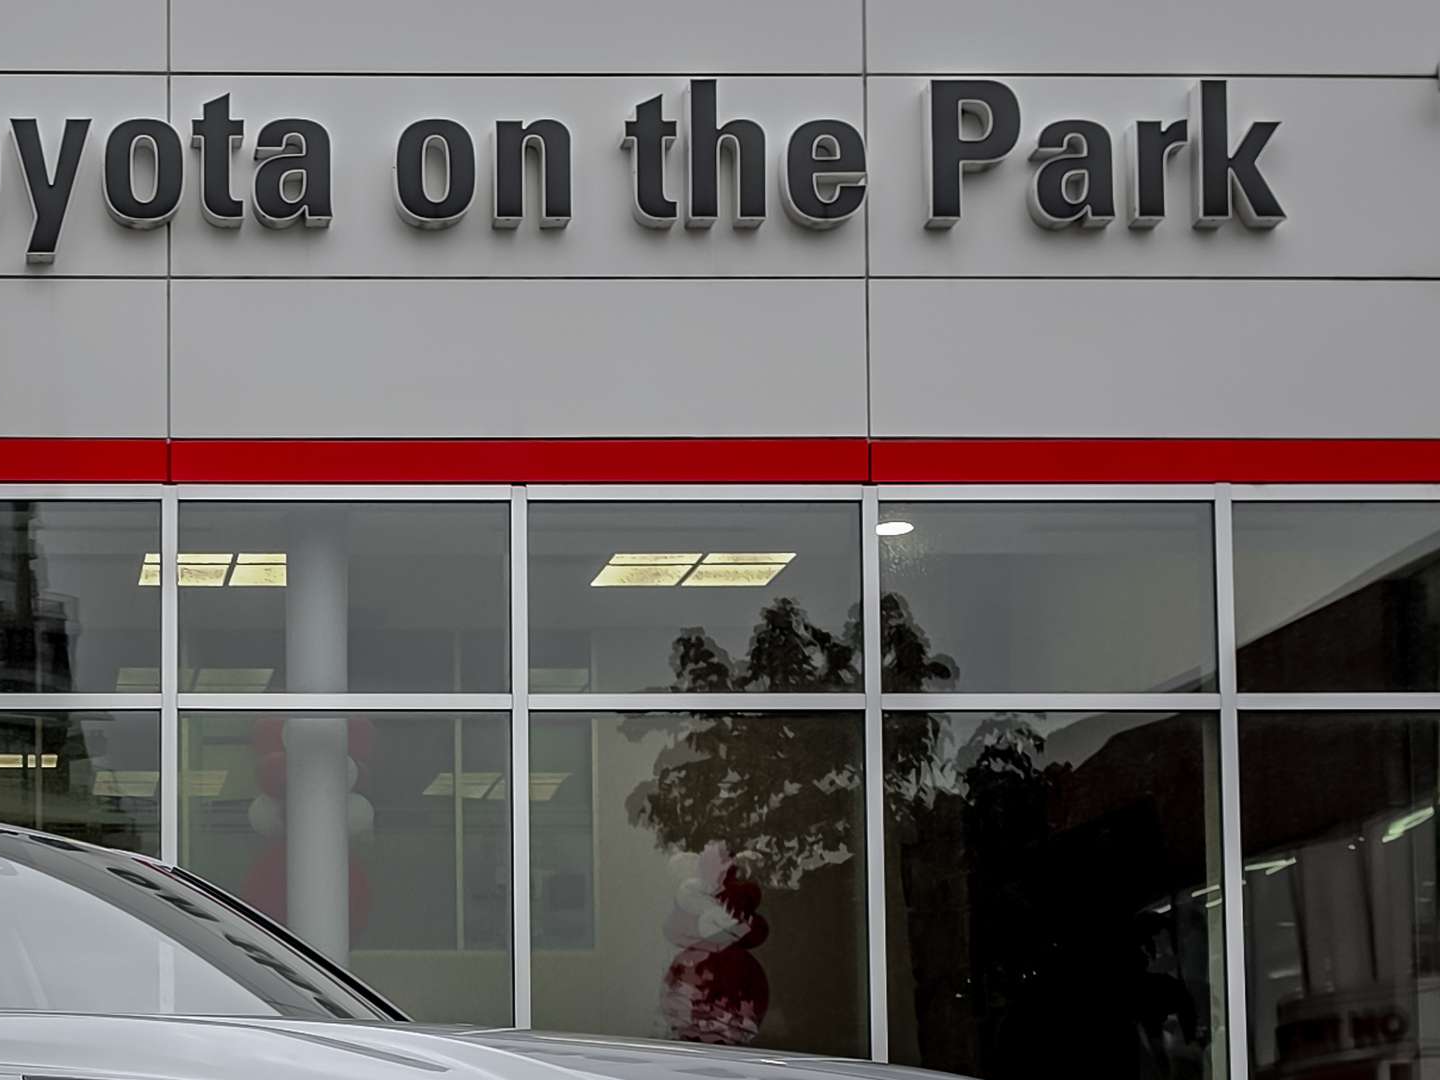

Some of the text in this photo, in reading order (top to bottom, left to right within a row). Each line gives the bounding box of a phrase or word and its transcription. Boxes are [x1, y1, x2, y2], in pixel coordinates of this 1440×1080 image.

[395, 118, 573, 229] on
[621, 79, 868, 229] the
[924, 79, 1287, 230] Park
